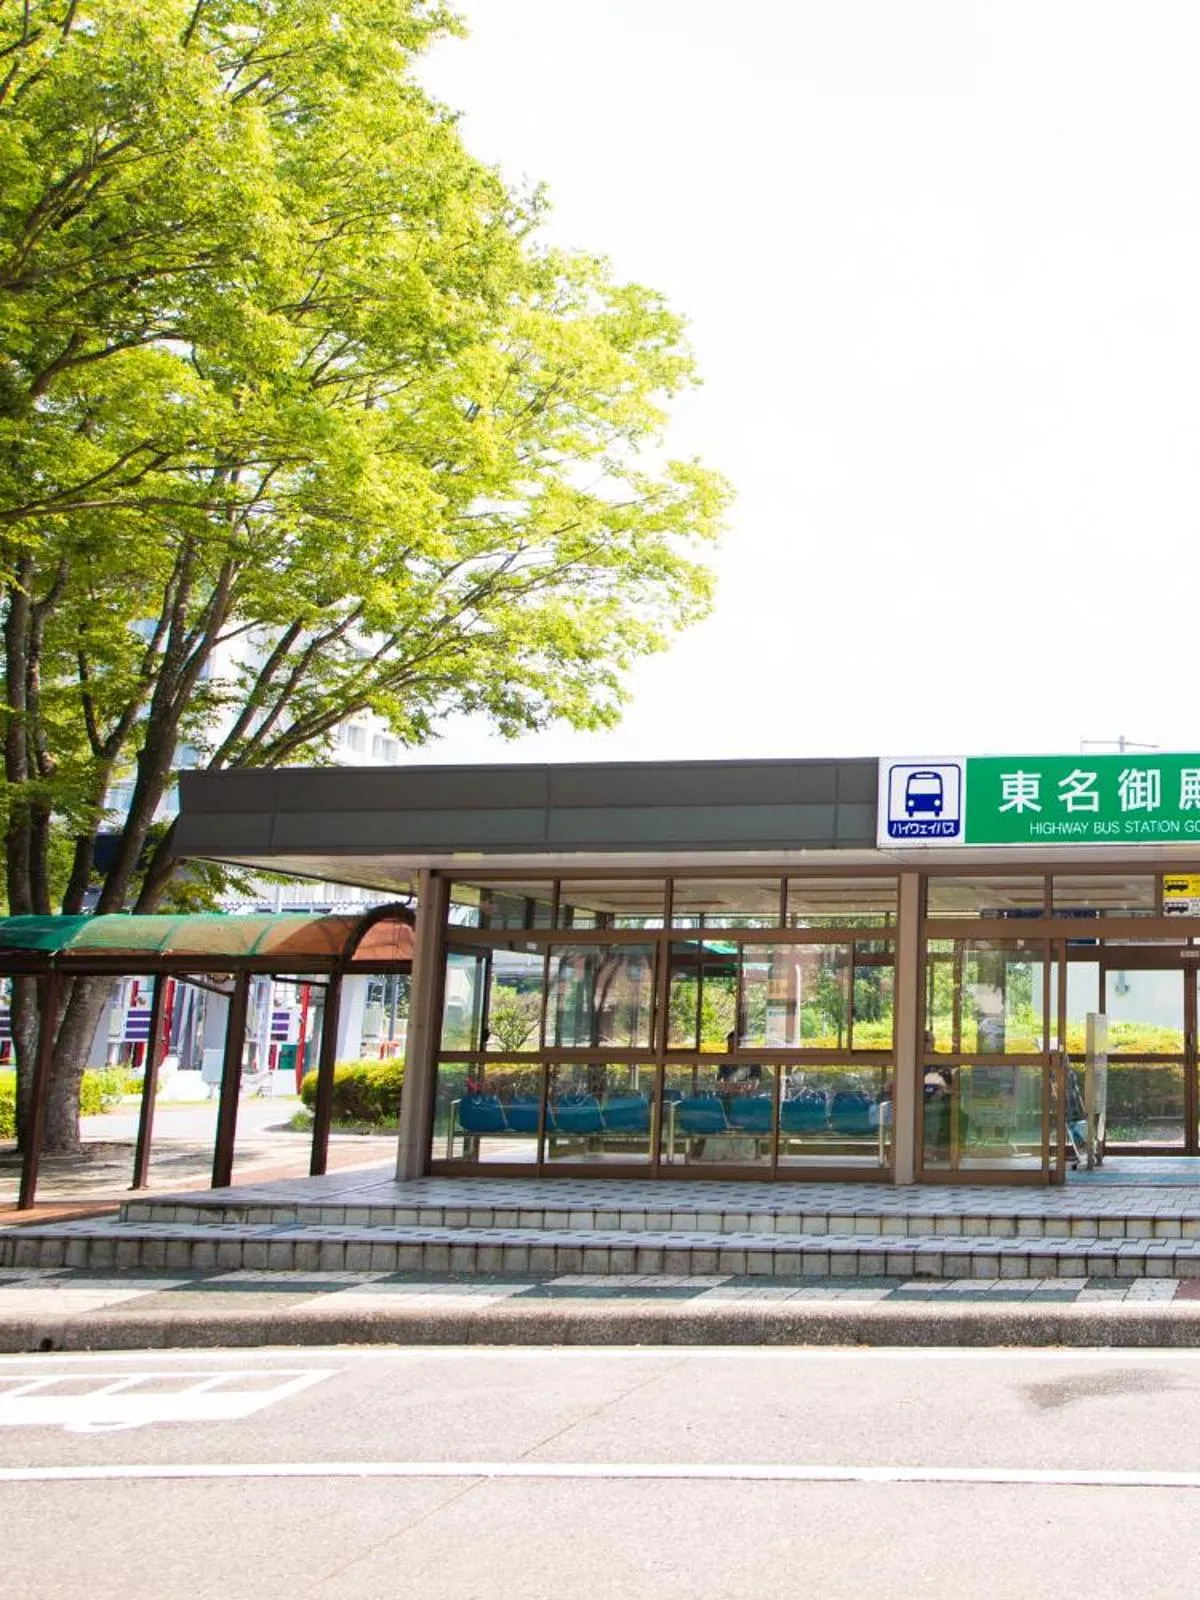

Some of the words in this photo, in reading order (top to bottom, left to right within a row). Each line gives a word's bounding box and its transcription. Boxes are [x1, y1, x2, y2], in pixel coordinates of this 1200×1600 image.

[892, 821, 955, 835] ハイウェイバス
[1029, 821, 1089, 835] HIGHWAY
[1093, 821, 1120, 834] BUS
[1124, 820, 1180, 834] STATION
